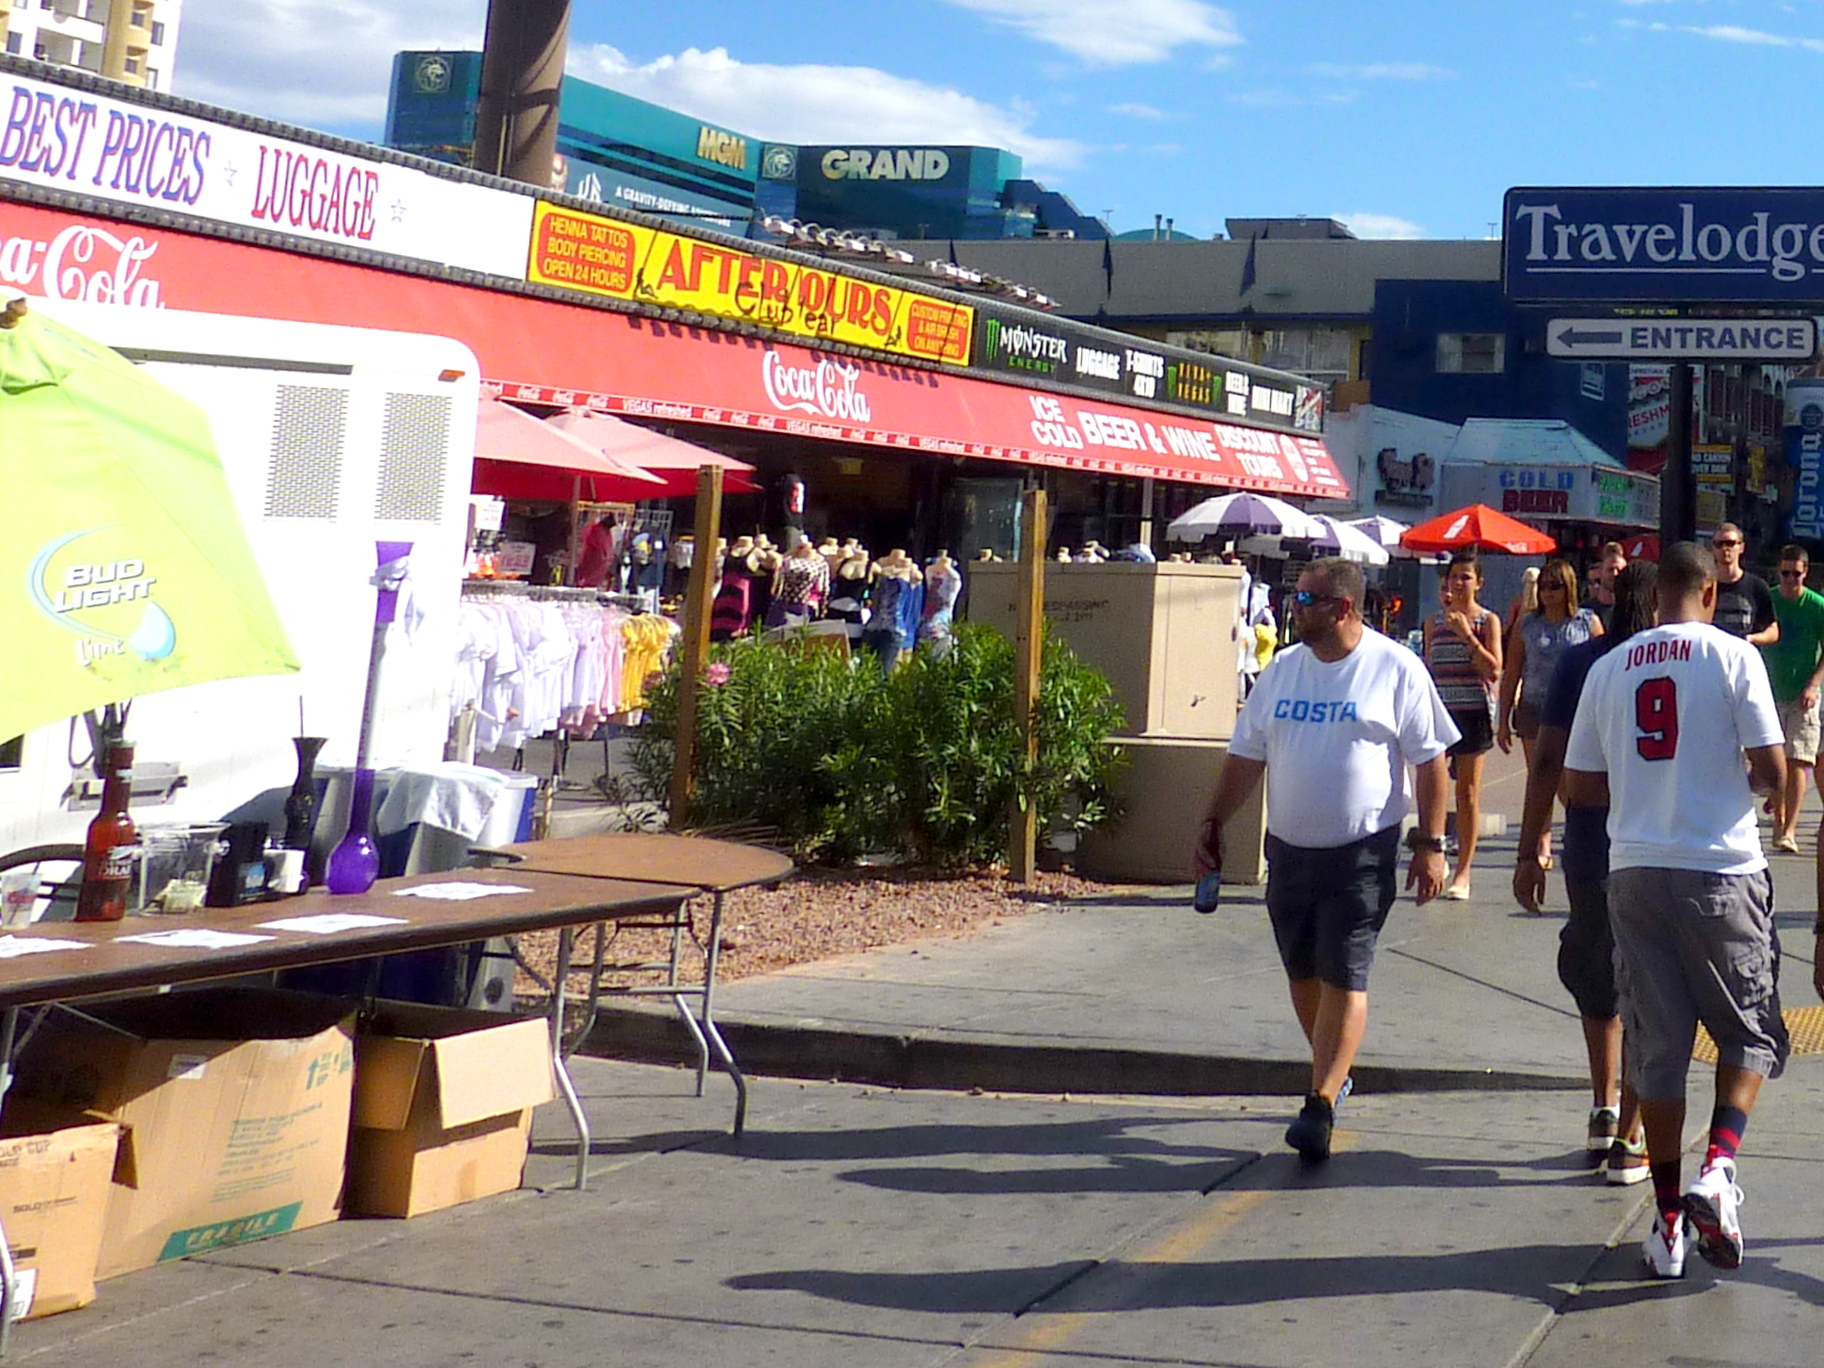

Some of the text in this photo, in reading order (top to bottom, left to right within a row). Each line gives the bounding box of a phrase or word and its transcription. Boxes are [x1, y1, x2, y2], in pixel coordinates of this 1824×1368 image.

[0, 85, 380, 241] BEST PRICES LUGGAGE
[699, 126, 746, 170] MGM
[821, 149, 950, 180] GRAND
[550, 216, 628, 248] HENNA TATTOS
[548, 237, 626, 268] BODY PIERCING
[543, 258, 626, 289] OPEN 24 HOURS
[657, 239, 789, 303] AFTER
[1000, 325, 1067, 364] MONSTER
[1630, 327, 1805, 350] ENTRANCE
[1076, 346, 1121, 380] LUGGAGE
[763, 350, 870, 423] Coca-Cola
[1177, 382, 1212, 405] VEGAS
[1029, 395, 1065, 422] ICE
[1031, 411, 1221, 462] COLD BEER & WINE
[1213, 424, 1284, 457] DISCOUNT
[1236, 453, 1284, 481] TOURS
[1500, 469, 1574, 489] COLD
[1502, 489, 1568, 514] BEER
[66, 559, 144, 588] BUD
[54, 578, 157, 613] LIGHT
[1624, 639, 1692, 672] JORDAN
[1274, 699, 1357, 724] COSTA
[1636, 675, 1678, 761] 9
